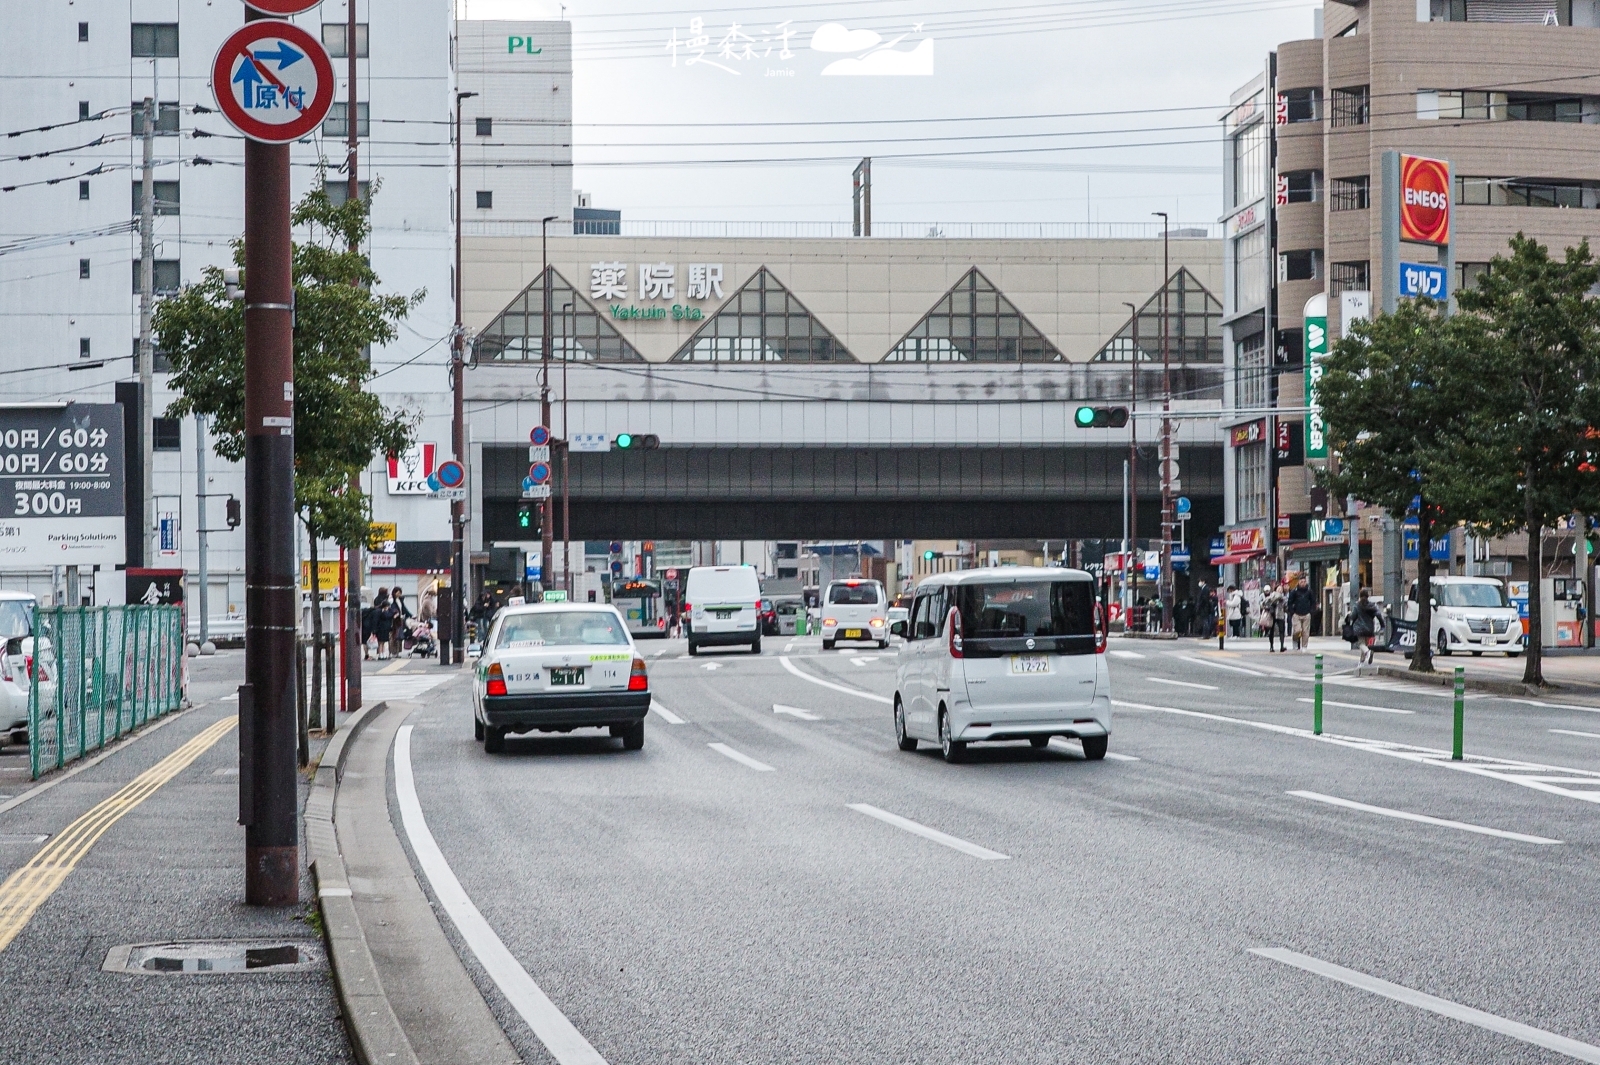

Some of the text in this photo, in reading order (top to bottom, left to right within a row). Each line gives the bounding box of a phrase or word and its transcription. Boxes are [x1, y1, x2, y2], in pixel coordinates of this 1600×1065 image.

[508, 36, 542, 54] PL
[255, 85, 306, 110] 原付
[1405, 187, 1447, 210] ENEOS
[590, 261, 724, 300] 薬院駅
[1405, 267, 1442, 295] セルフ
[610, 304, 705, 319] Yakuin Sta.
[1278, 422, 1288, 447] スト
[15, 480, 66, 490] 夜間最大料金
[396, 481, 426, 491] KFC
[15, 492, 81, 515] 300円
[48, 532, 117, 542] Parking Solutions
[604, 670, 616, 678] 114
